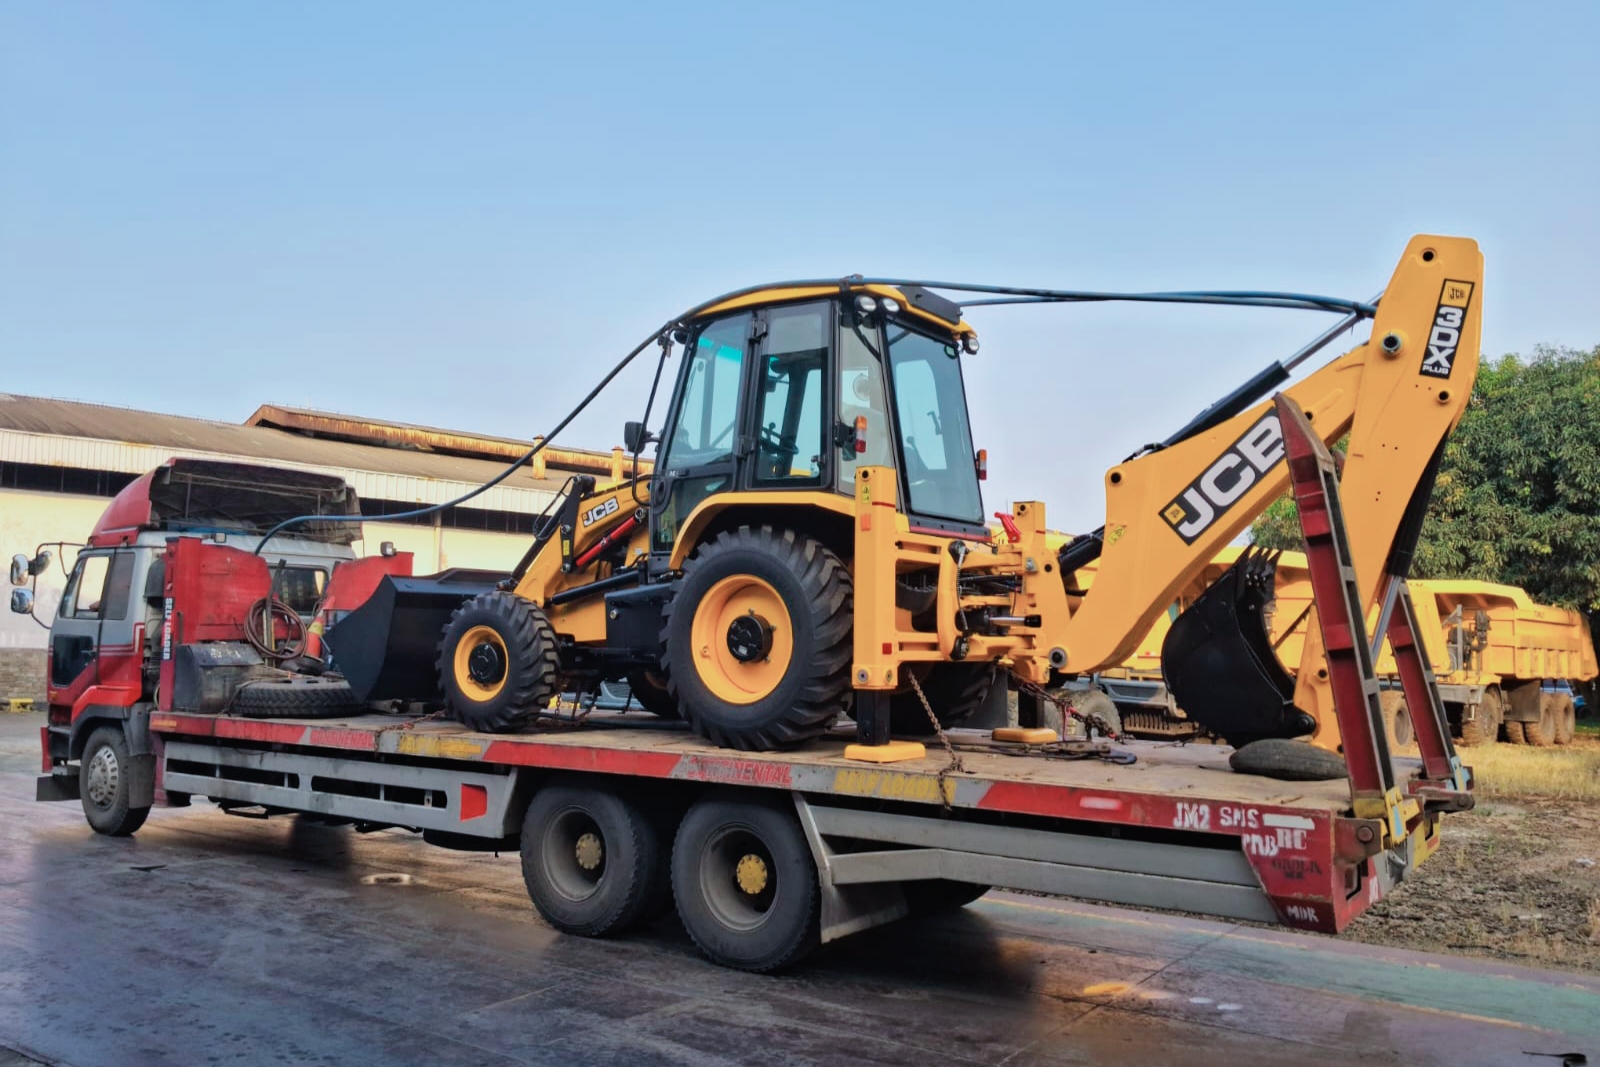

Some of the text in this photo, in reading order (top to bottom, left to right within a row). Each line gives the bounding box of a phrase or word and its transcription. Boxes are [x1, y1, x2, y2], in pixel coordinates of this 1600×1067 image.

[1423, 306, 1463, 368] 3DX
[1422, 365, 1449, 375] PLUS
[1177, 415, 1286, 538] JCB
[583, 497, 619, 526] JCB
[163, 597, 173, 660] SELF LOADER
[687, 756, 792, 785] NENTAL
[1173, 802, 1211, 830] JM2
